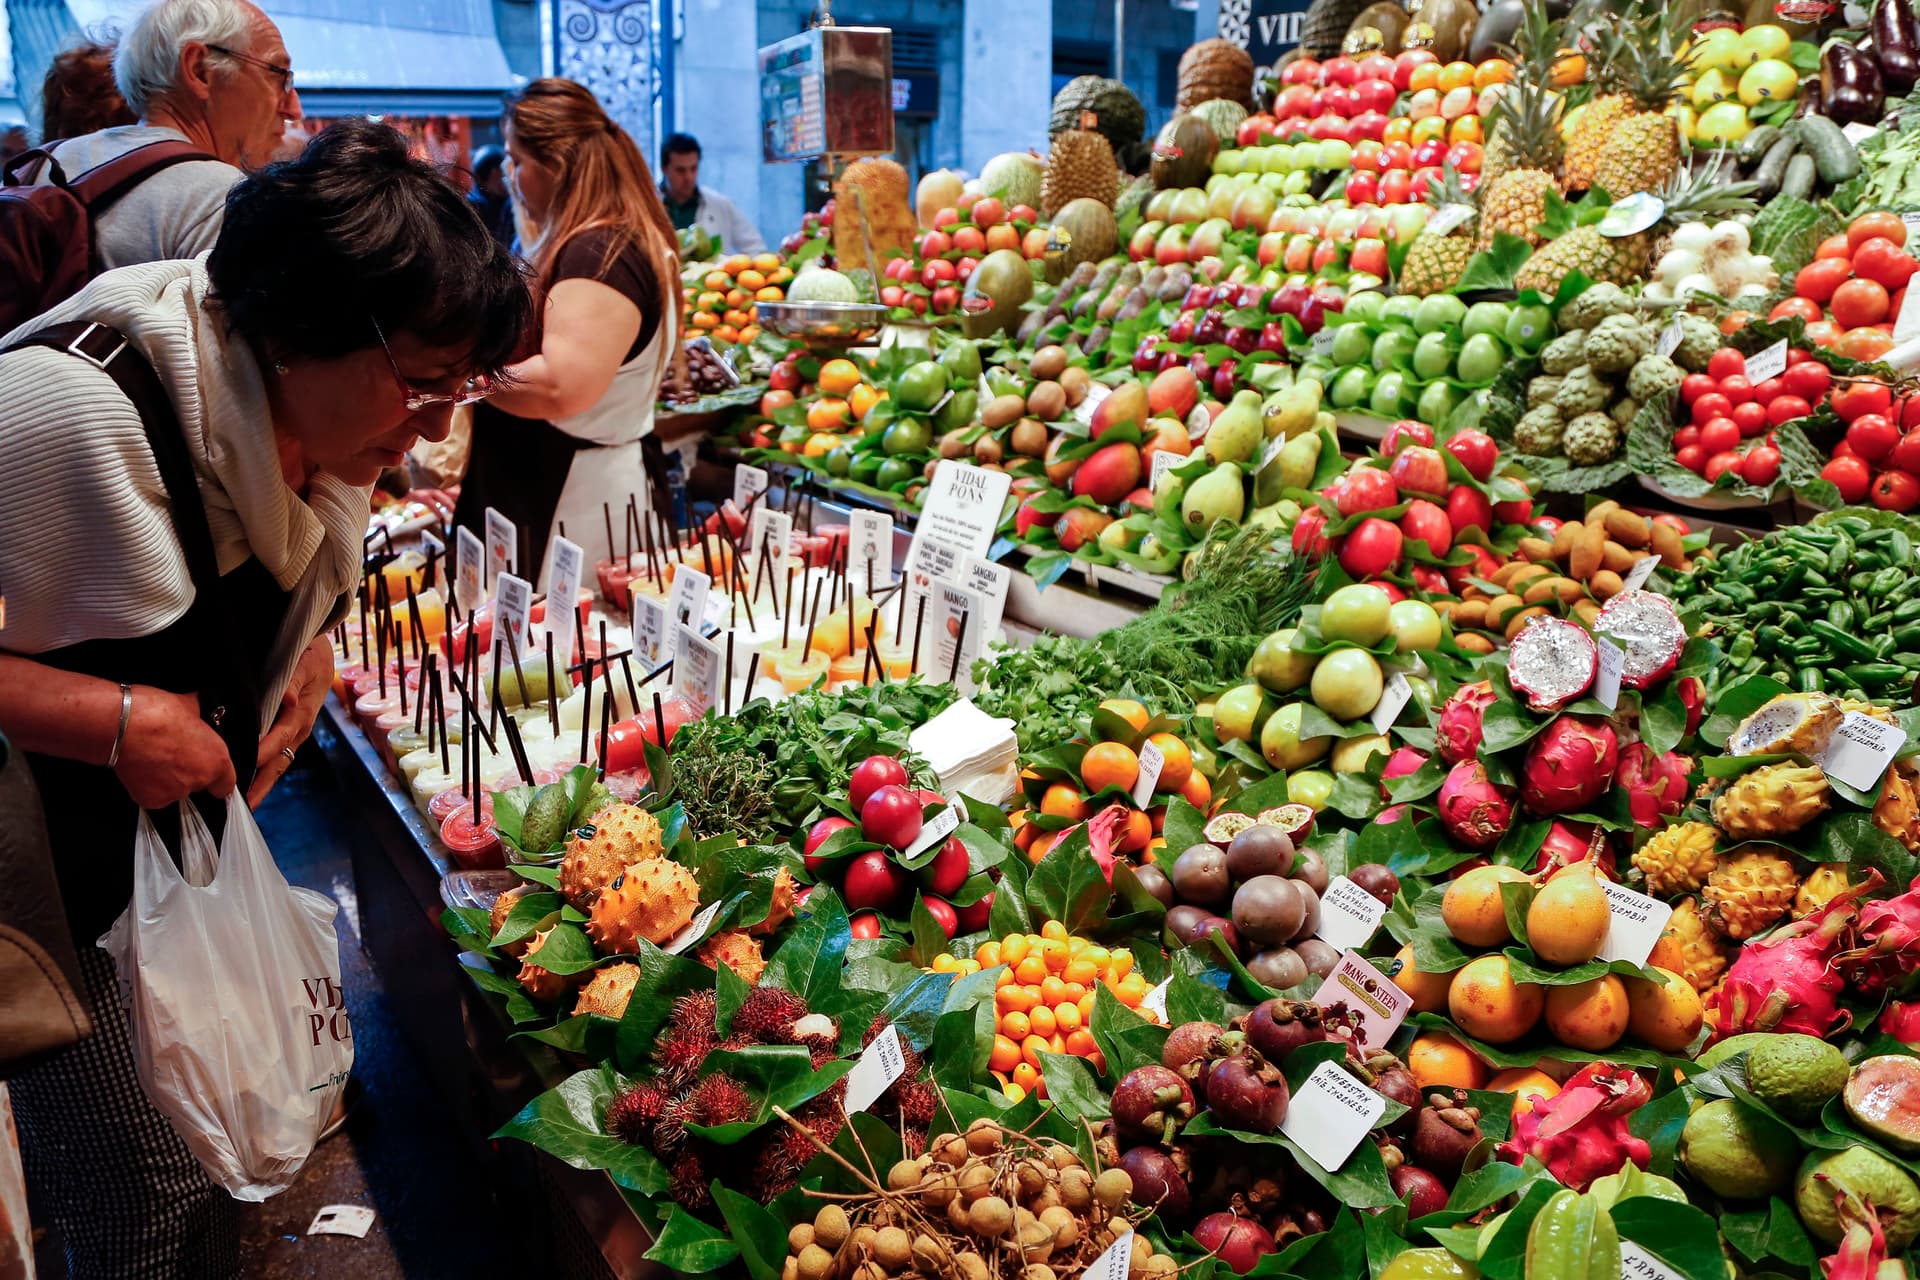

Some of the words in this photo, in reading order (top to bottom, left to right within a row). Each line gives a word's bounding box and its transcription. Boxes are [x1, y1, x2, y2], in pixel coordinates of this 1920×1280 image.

[955, 468, 987, 489] VIDAL
[948, 483, 984, 504] PONS
[972, 565, 998, 583] SANGRIA
[943, 590, 969, 609] MANGO
[1327, 1086, 1370, 1117] INDONESIA
